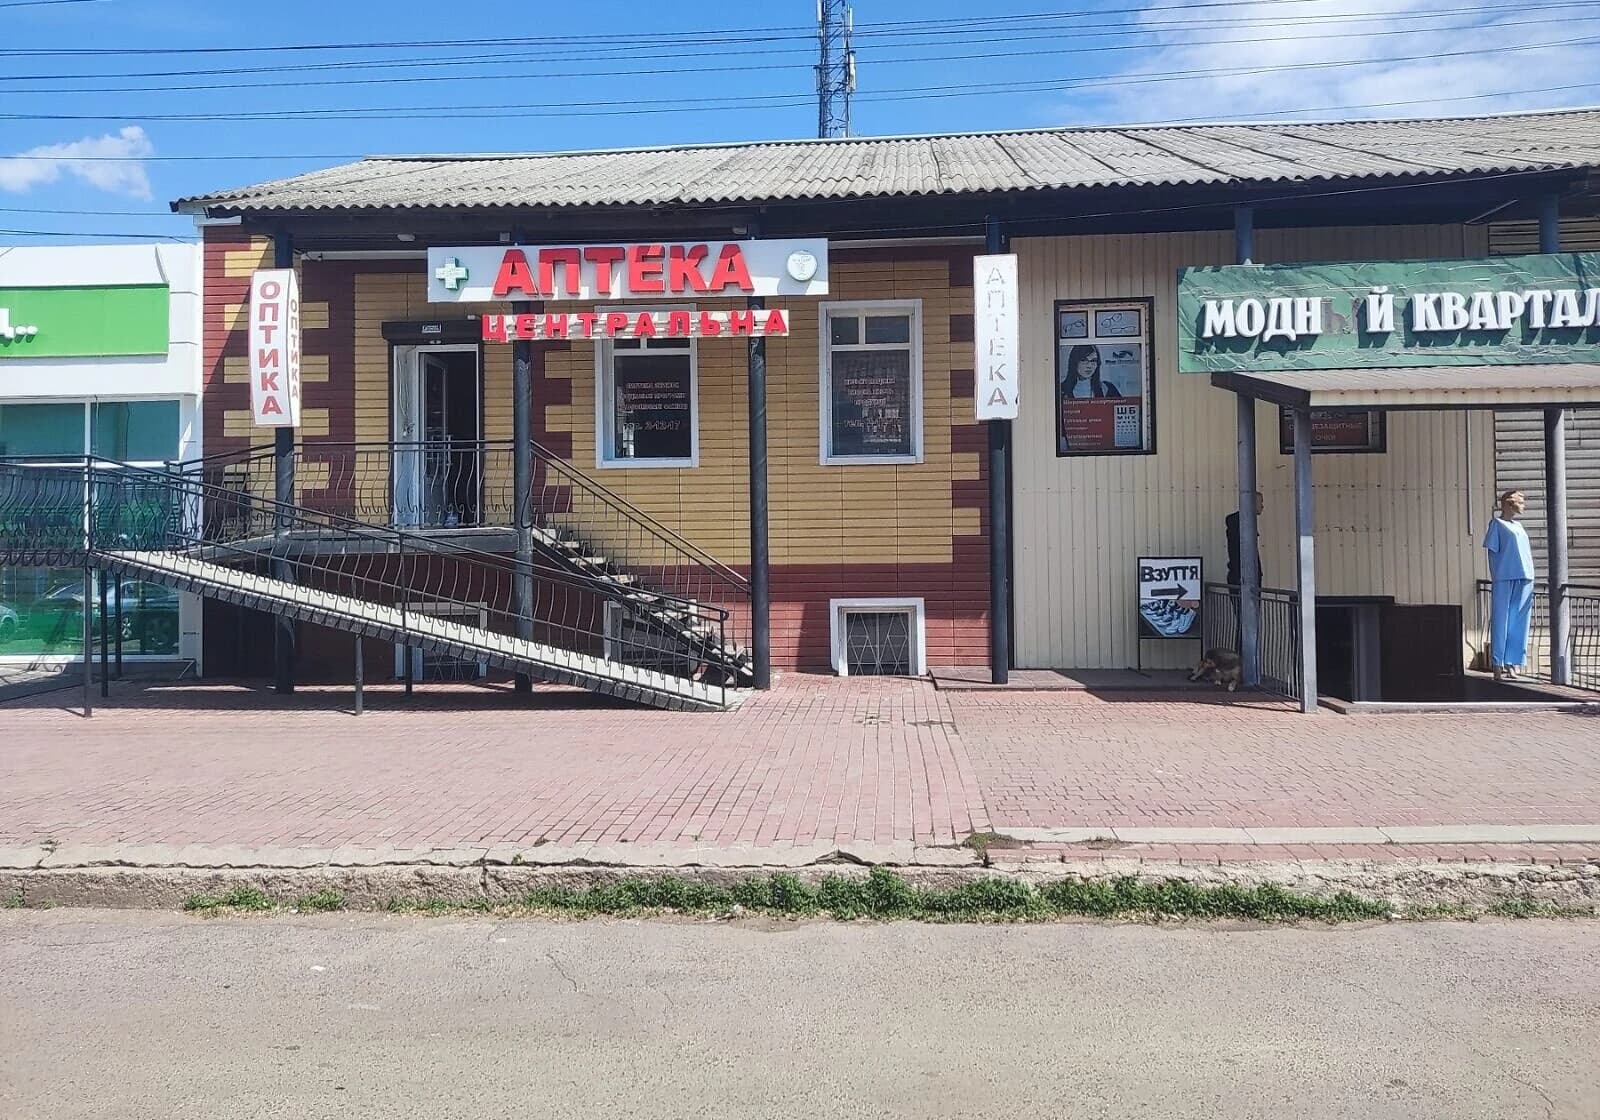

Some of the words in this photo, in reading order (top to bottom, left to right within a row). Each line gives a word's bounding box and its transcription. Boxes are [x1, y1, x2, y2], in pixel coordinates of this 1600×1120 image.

[493, 243, 755, 296] АПТЕКА
[258, 281, 283, 415] ОПТИКА
[289, 298, 299, 399] ОПТИКА
[481, 308, 788, 343] ЦЕНТРАЛЬНА
[986, 267, 1008, 406] АПТЕКА
